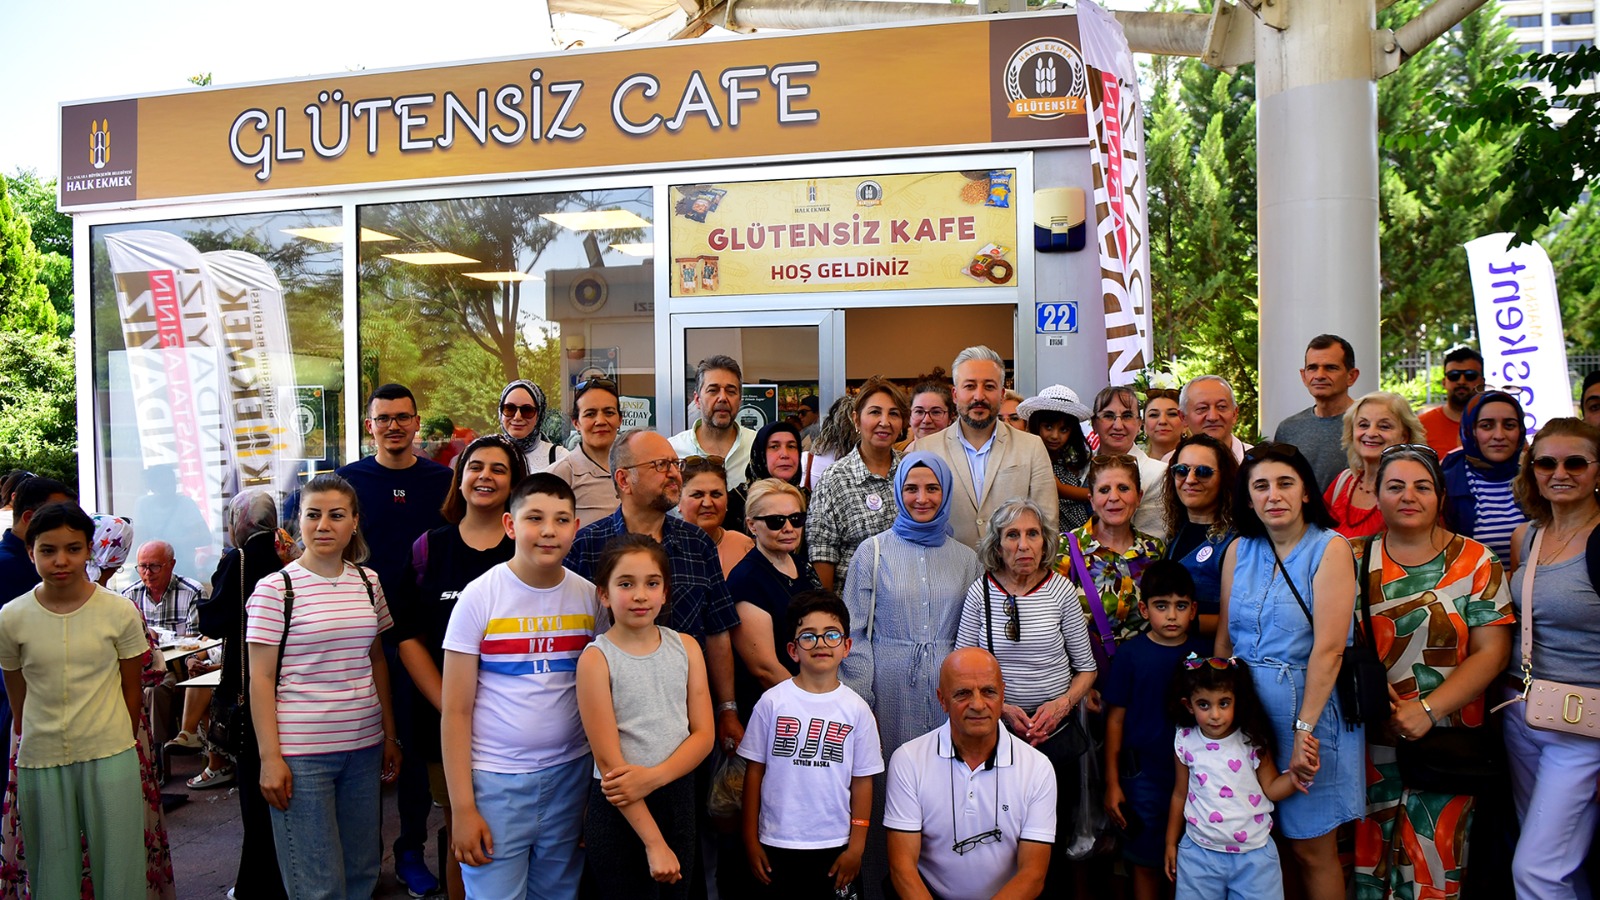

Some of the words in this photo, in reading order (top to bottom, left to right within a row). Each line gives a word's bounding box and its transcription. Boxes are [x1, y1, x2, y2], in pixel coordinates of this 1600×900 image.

[1018, 45, 1041, 62] HALK
[1044, 44, 1073, 60] EKMEK
[1016, 99, 1078, 112] GLÜTENSİZ
[228, 69, 587, 182] GLÜTENSİZ
[610, 60, 821, 136] CAFE
[66, 180, 95, 192] HALK
[95, 176, 132, 189] EKMEK
[708, 213, 881, 251] GLÜTENSİZ
[890, 216, 976, 244] KAFE
[771, 264, 812, 283] HOŞ
[817, 257, 909, 279] GELDİNİZ
[1043, 304, 1071, 331] 22
[393, 489, 406, 497] US
[440, 590, 464, 601] SK
[517, 615, 563, 632] TOKYO
[529, 637, 555, 654] NYC
[533, 659, 551, 674] LA
[772, 716, 854, 763] BJK
